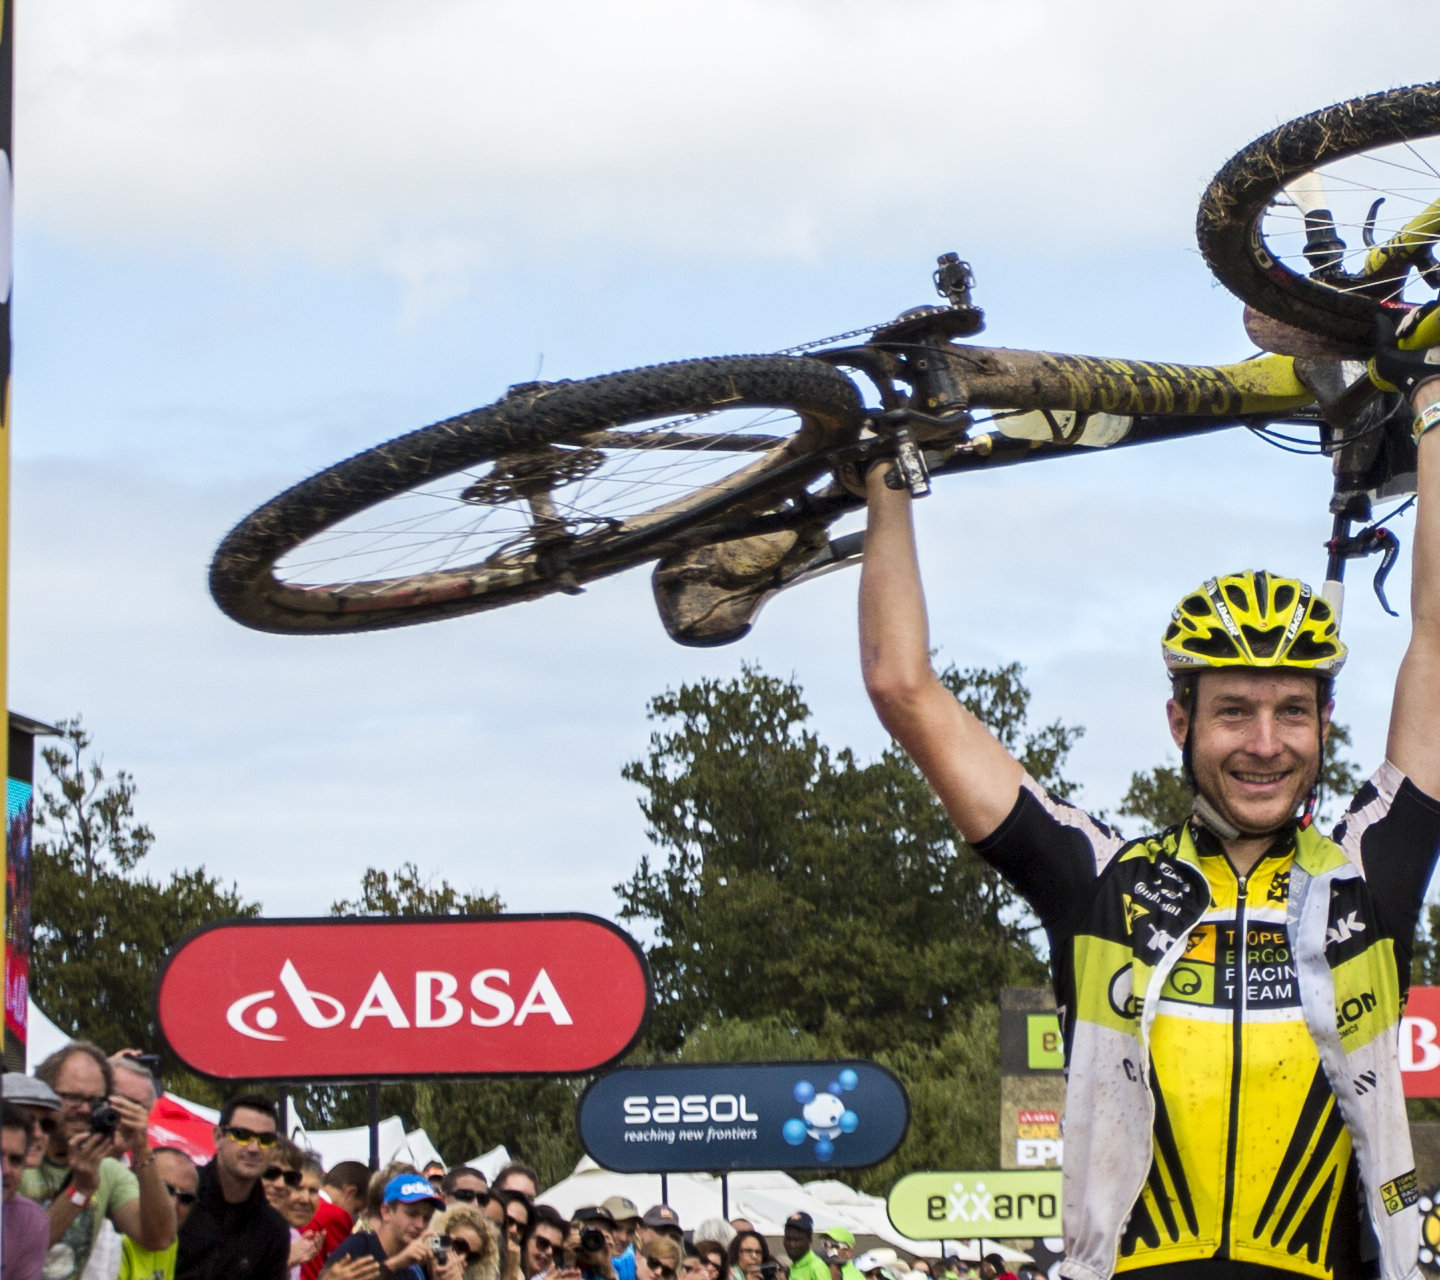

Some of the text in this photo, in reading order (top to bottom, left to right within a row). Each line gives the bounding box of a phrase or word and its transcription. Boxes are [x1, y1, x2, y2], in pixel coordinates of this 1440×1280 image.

[349, 967, 574, 1030] ABSA
[1224, 983, 1293, 1001] TEAM
[623, 1125, 758, 1145] reaching new frontiers
[927, 1182, 1057, 1223] exxaro
